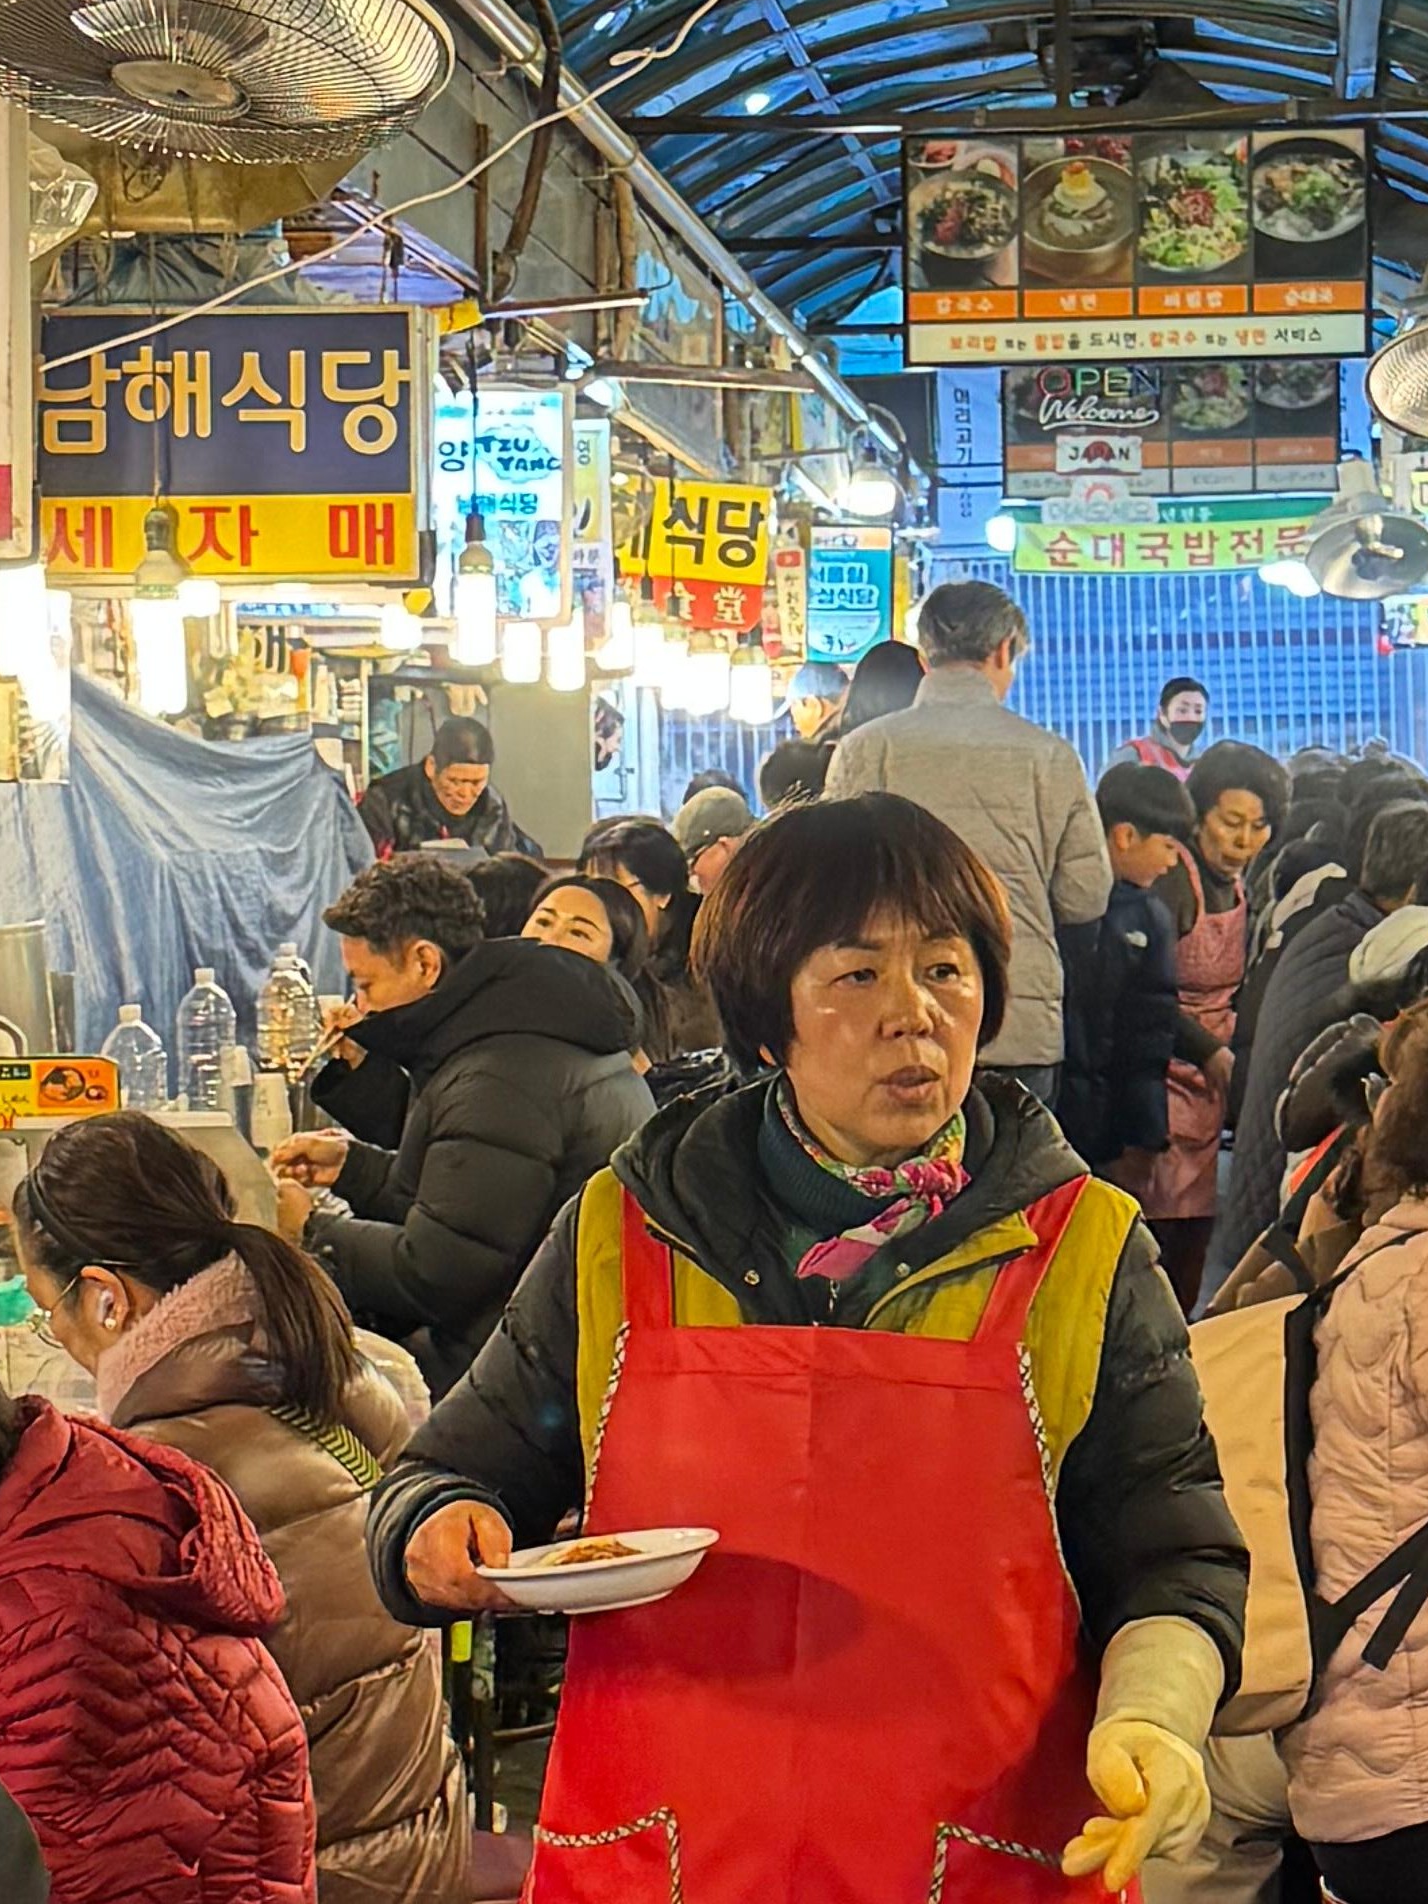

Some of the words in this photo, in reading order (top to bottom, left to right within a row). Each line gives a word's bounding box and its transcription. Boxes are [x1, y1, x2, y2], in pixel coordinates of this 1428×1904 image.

[38, 346, 413, 455] 남해식당
[1036, 366, 1162, 398] OPEN
[630, 496, 764, 568] 식당
[1043, 524, 1308, 569] 순대국밥전문
